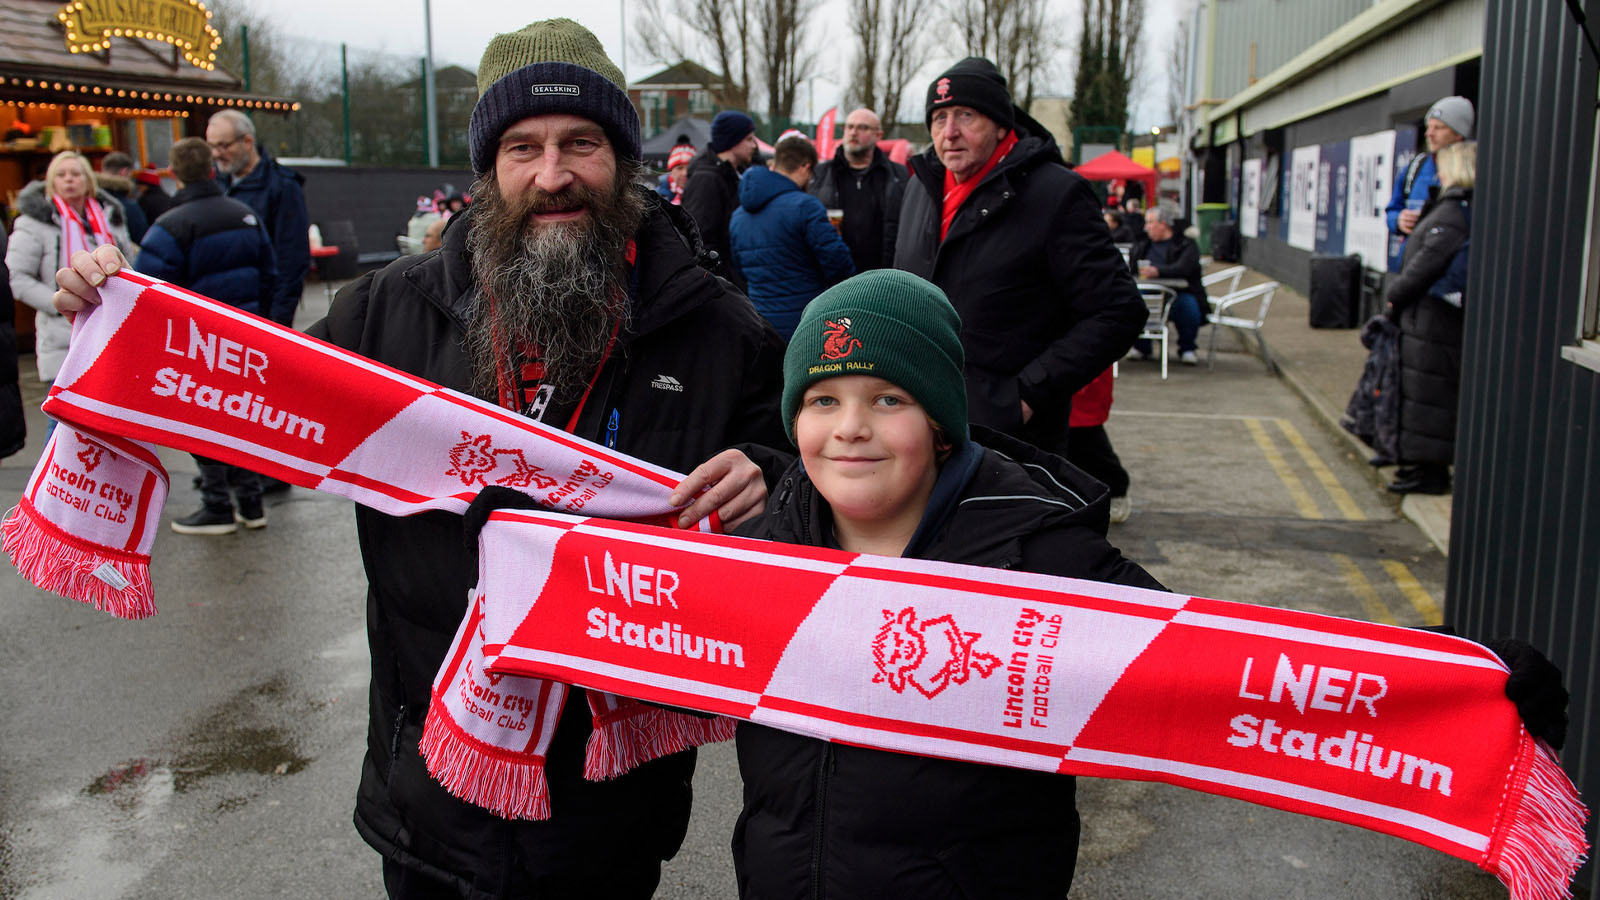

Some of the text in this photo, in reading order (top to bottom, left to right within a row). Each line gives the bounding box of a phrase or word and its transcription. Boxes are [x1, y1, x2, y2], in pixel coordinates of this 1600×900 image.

[160, 3, 198, 39] GRILL
[165, 317, 269, 384] LNER
[804, 361, 874, 375] DRAGON RALLY
[151, 367, 326, 445] Stadium
[651, 381, 684, 392] TRESPASS
[46, 481, 127, 524] ootball Club
[99, 482, 133, 511] City
[584, 550, 679, 609] LNER
[586, 607, 745, 668] Stadium
[1003, 607, 1045, 728] Lincoln City
[1030, 614, 1063, 728] Football Club
[1239, 653, 1388, 717] LNER
[497, 715, 527, 731] Club
[503, 694, 533, 719] City
[1227, 714, 1453, 797] Stadium
